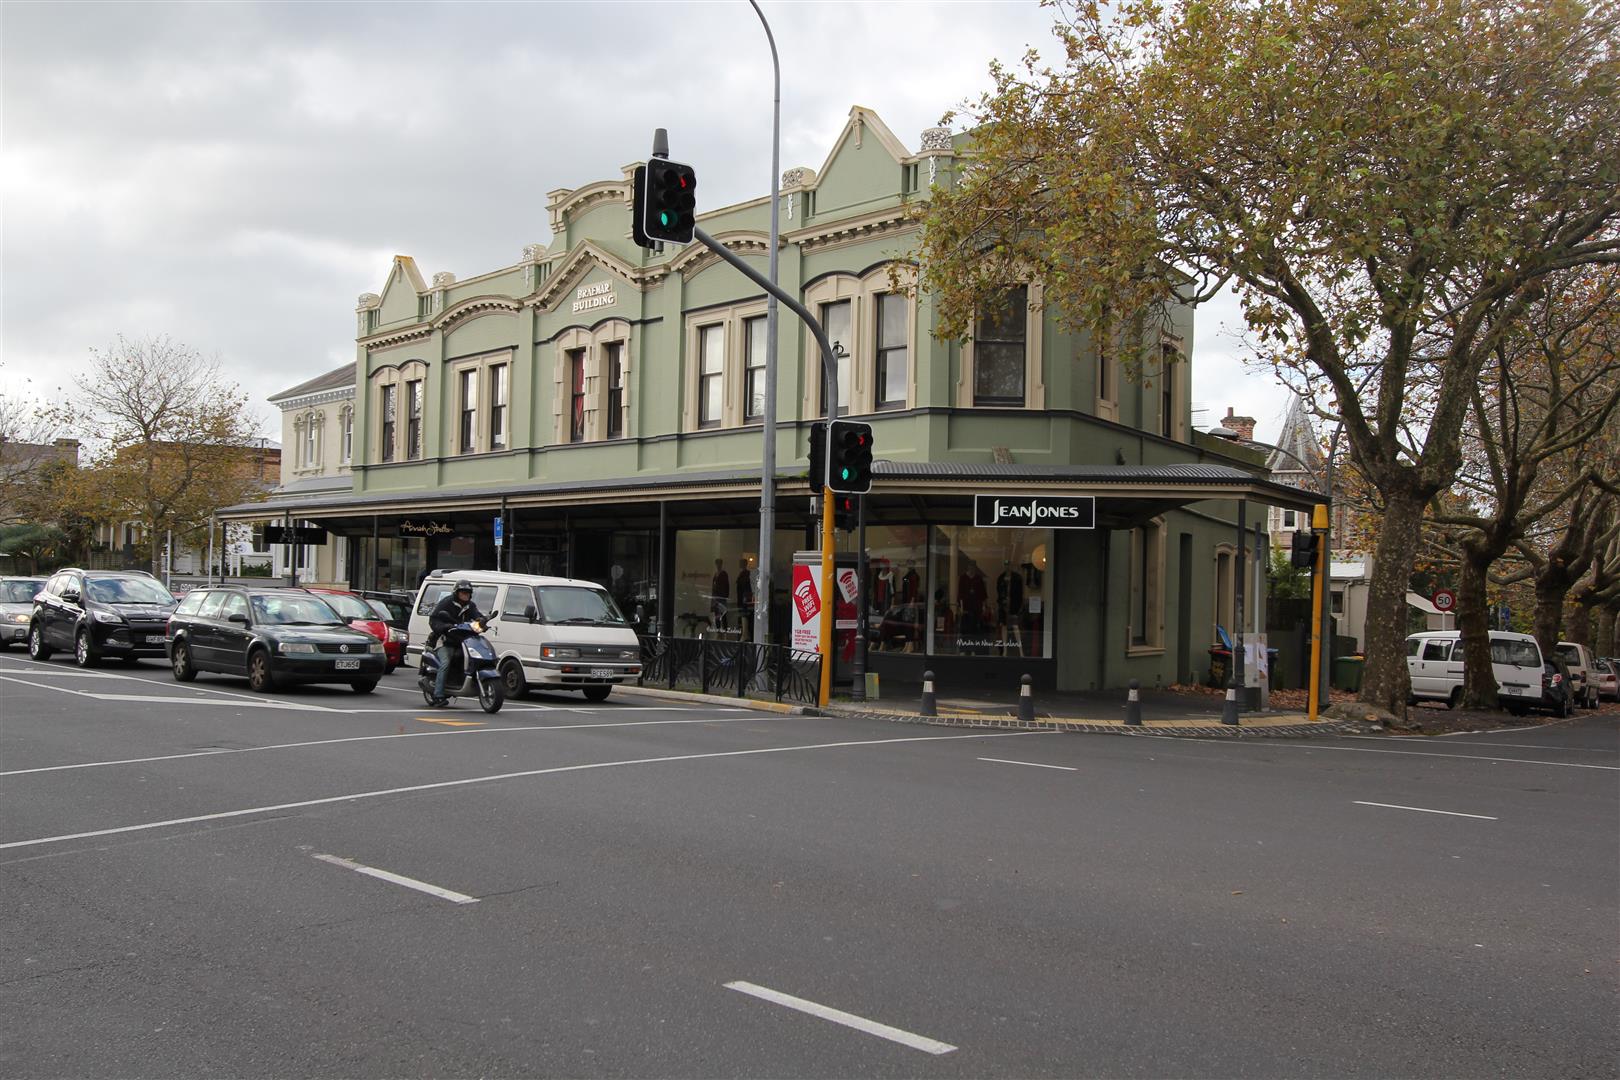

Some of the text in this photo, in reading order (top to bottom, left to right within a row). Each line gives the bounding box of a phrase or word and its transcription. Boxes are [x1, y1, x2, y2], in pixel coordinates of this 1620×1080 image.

[577, 283, 610, 299] BRAEMAR
[572, 295, 614, 312] BUILDING
[1438, 597, 1450, 605] 50
